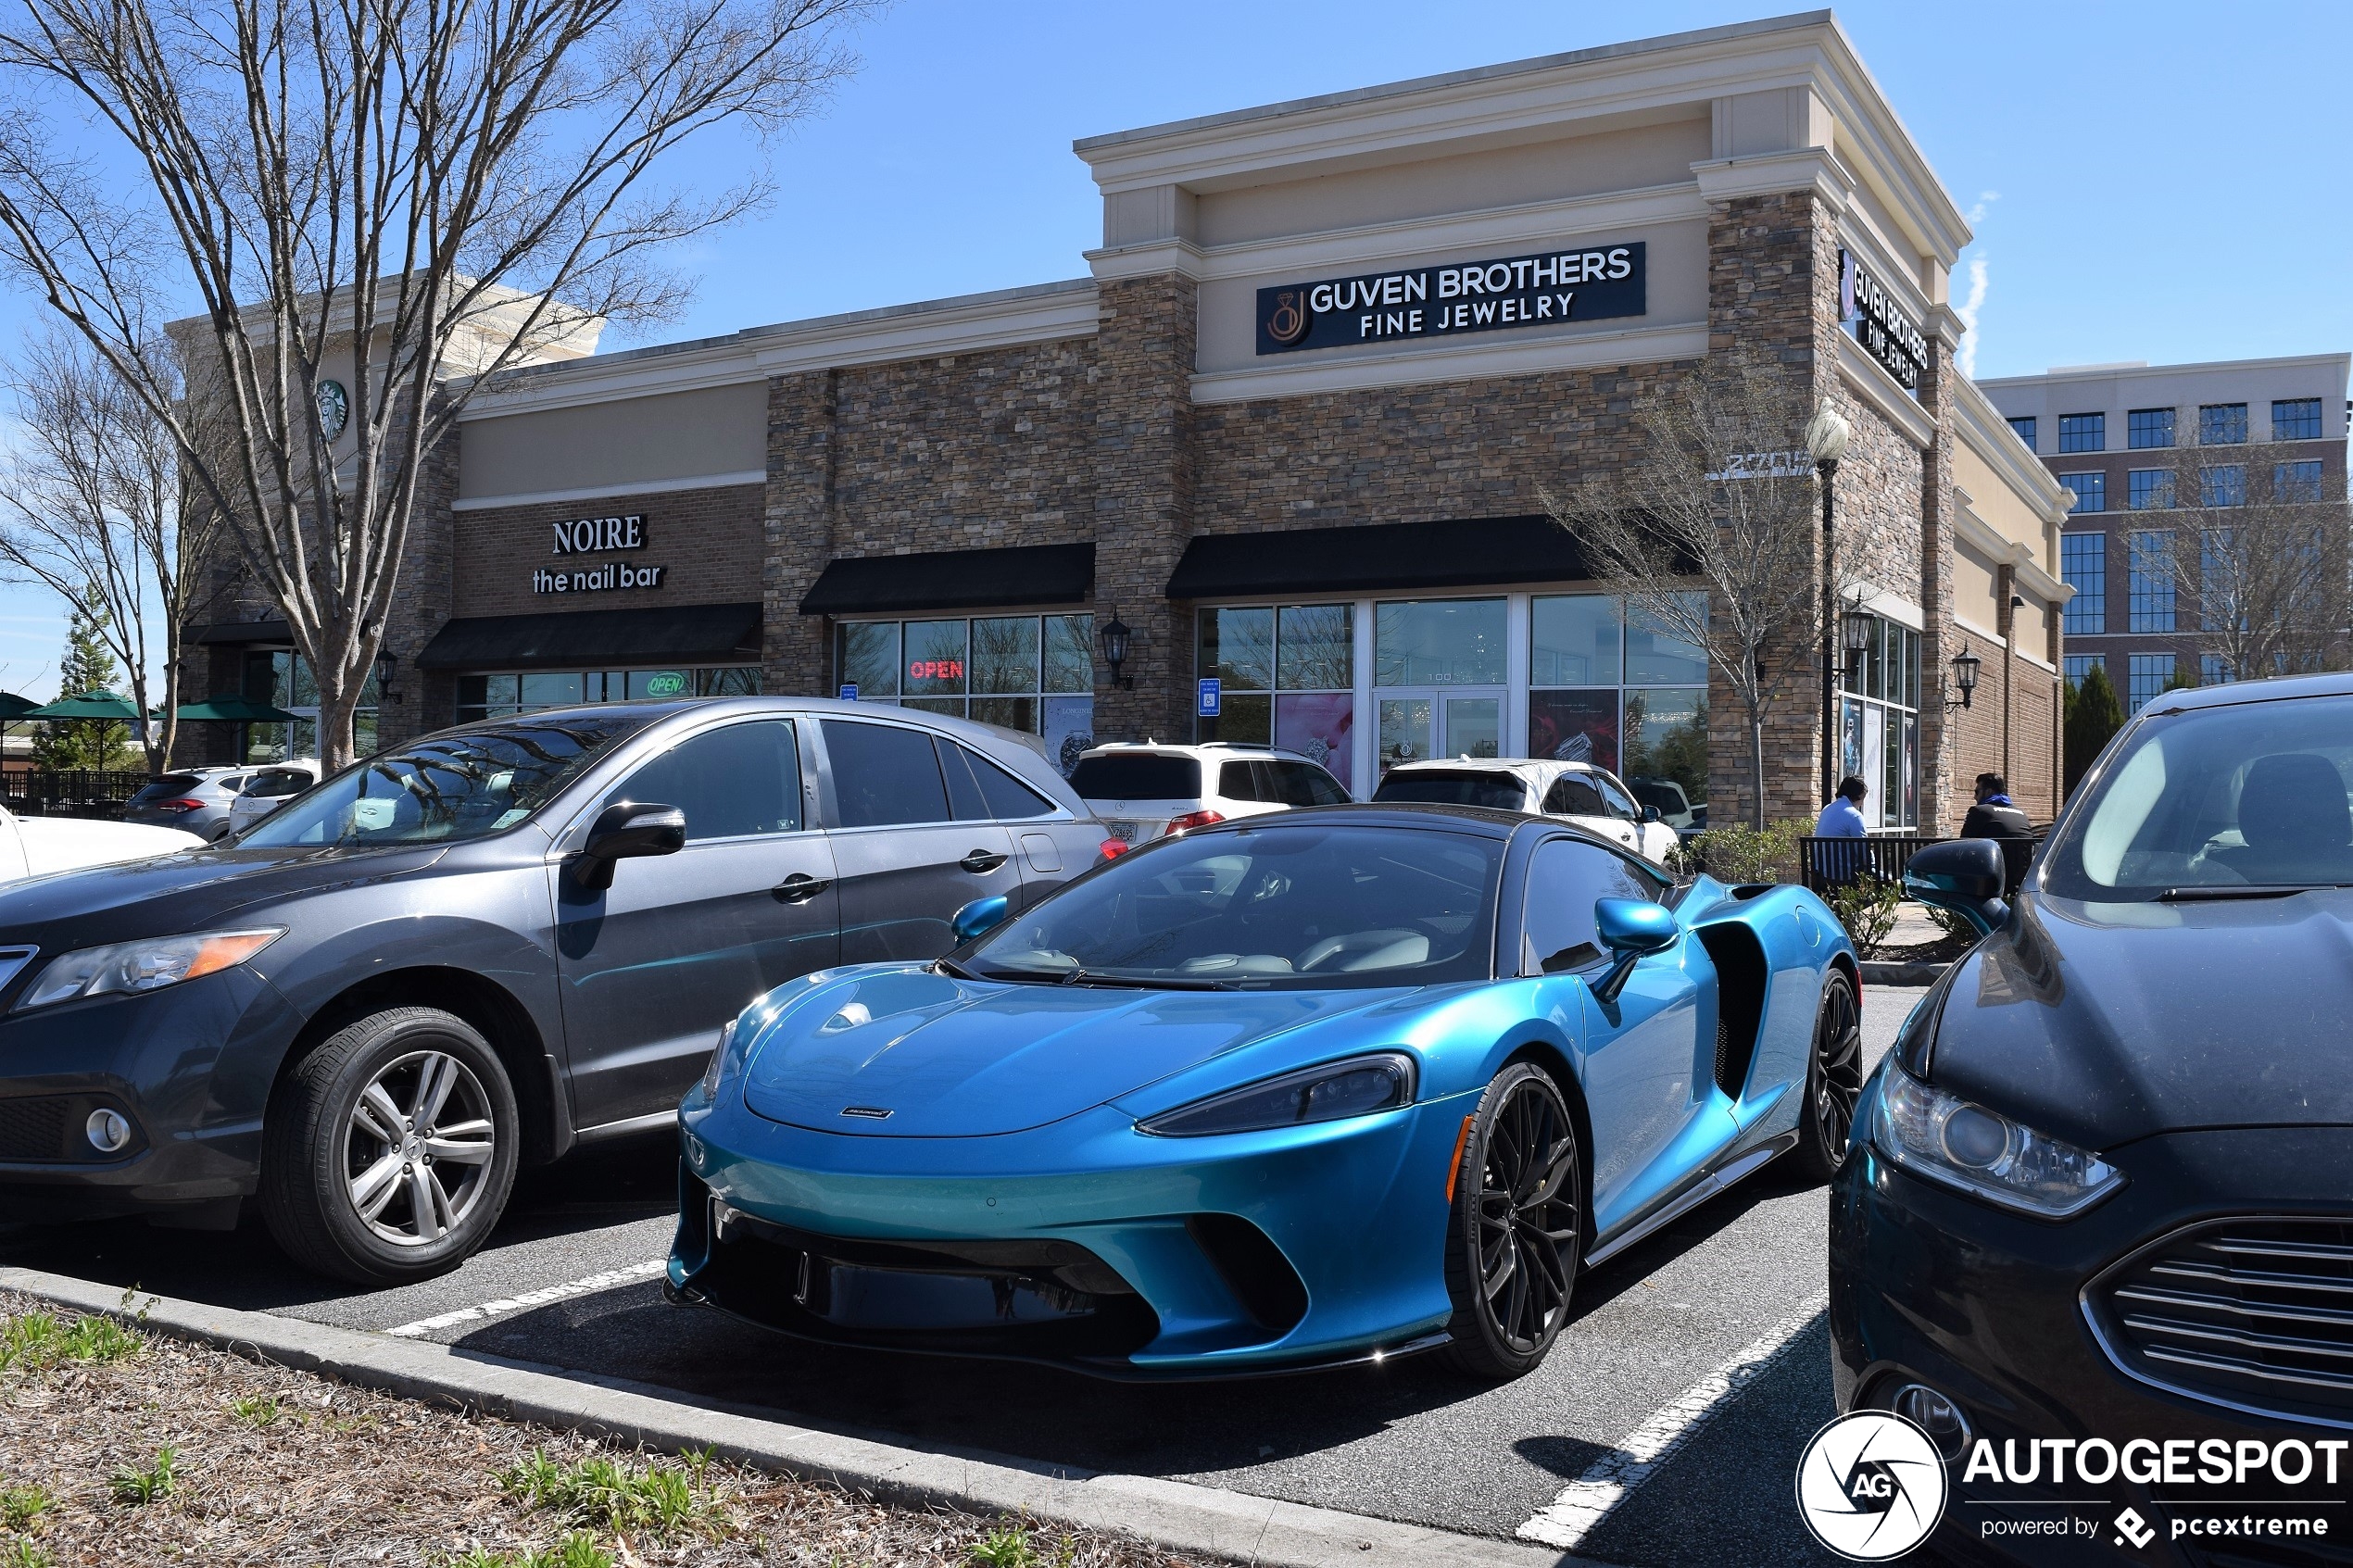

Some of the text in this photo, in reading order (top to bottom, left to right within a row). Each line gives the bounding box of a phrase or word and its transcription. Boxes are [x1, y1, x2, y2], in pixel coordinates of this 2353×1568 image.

[1310, 248, 1631, 313] GUVEN BROTHERS
[1361, 292, 1574, 337] FINE JEWELRY
[1854, 263, 1928, 370] GUVEN BROTHERS
[1869, 320, 1918, 389] FINE JEWELRY
[552, 515, 641, 554] NOIRE
[533, 563, 661, 593] the nail bar
[649, 677, 681, 692] OPEN
[911, 660, 963, 679] OPEN
